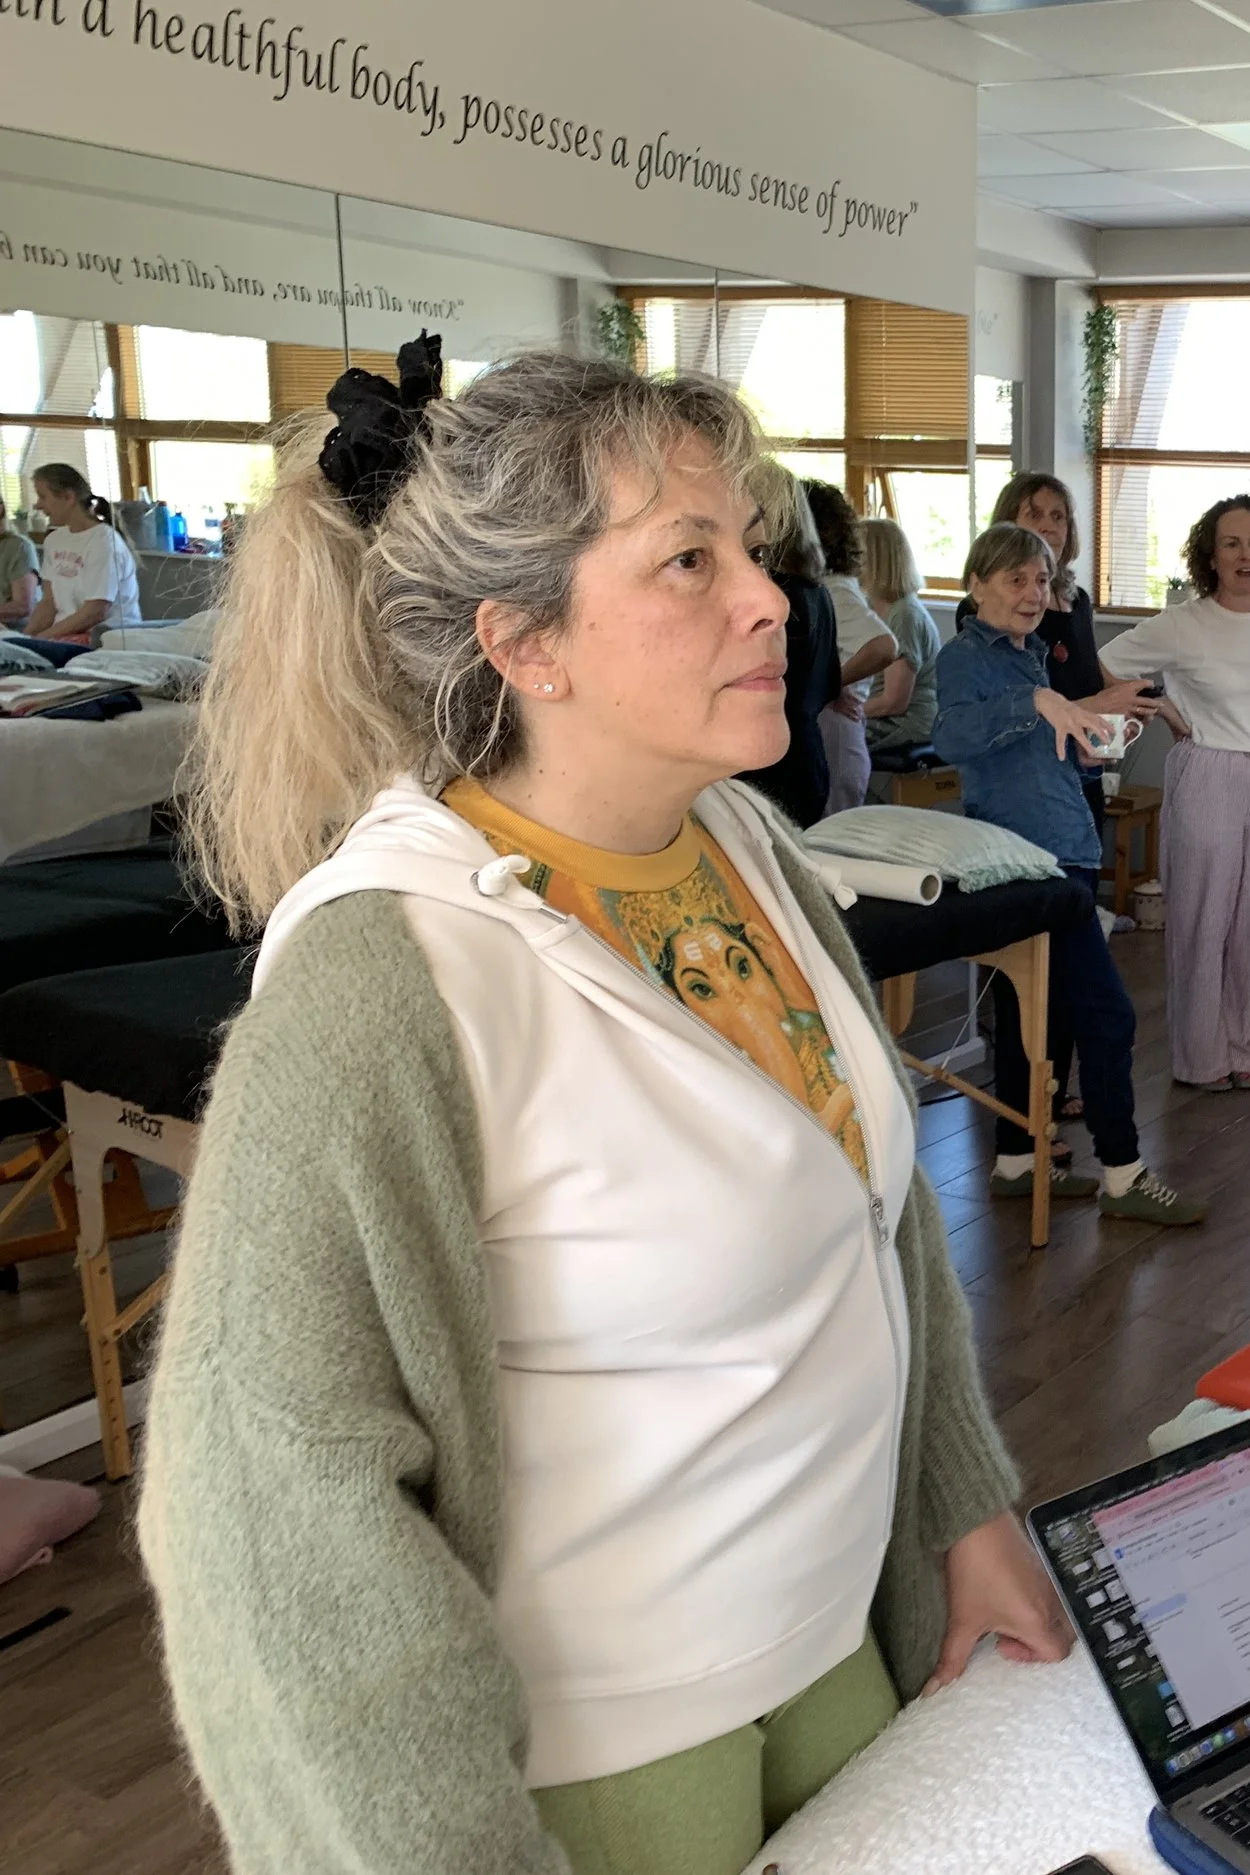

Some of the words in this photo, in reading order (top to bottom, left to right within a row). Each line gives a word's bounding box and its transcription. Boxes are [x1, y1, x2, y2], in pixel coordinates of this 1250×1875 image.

[82, 0, 115, 37] a
[133, 0, 347, 101] healthful
[351, 45, 446, 137] body,
[453, 93, 603, 161] possesses
[611, 135, 629, 168] a
[635, 131, 742, 197] glorious
[748, 172, 809, 213] sense
[816, 180, 841, 234] of
[838, 197, 920, 238] power”
